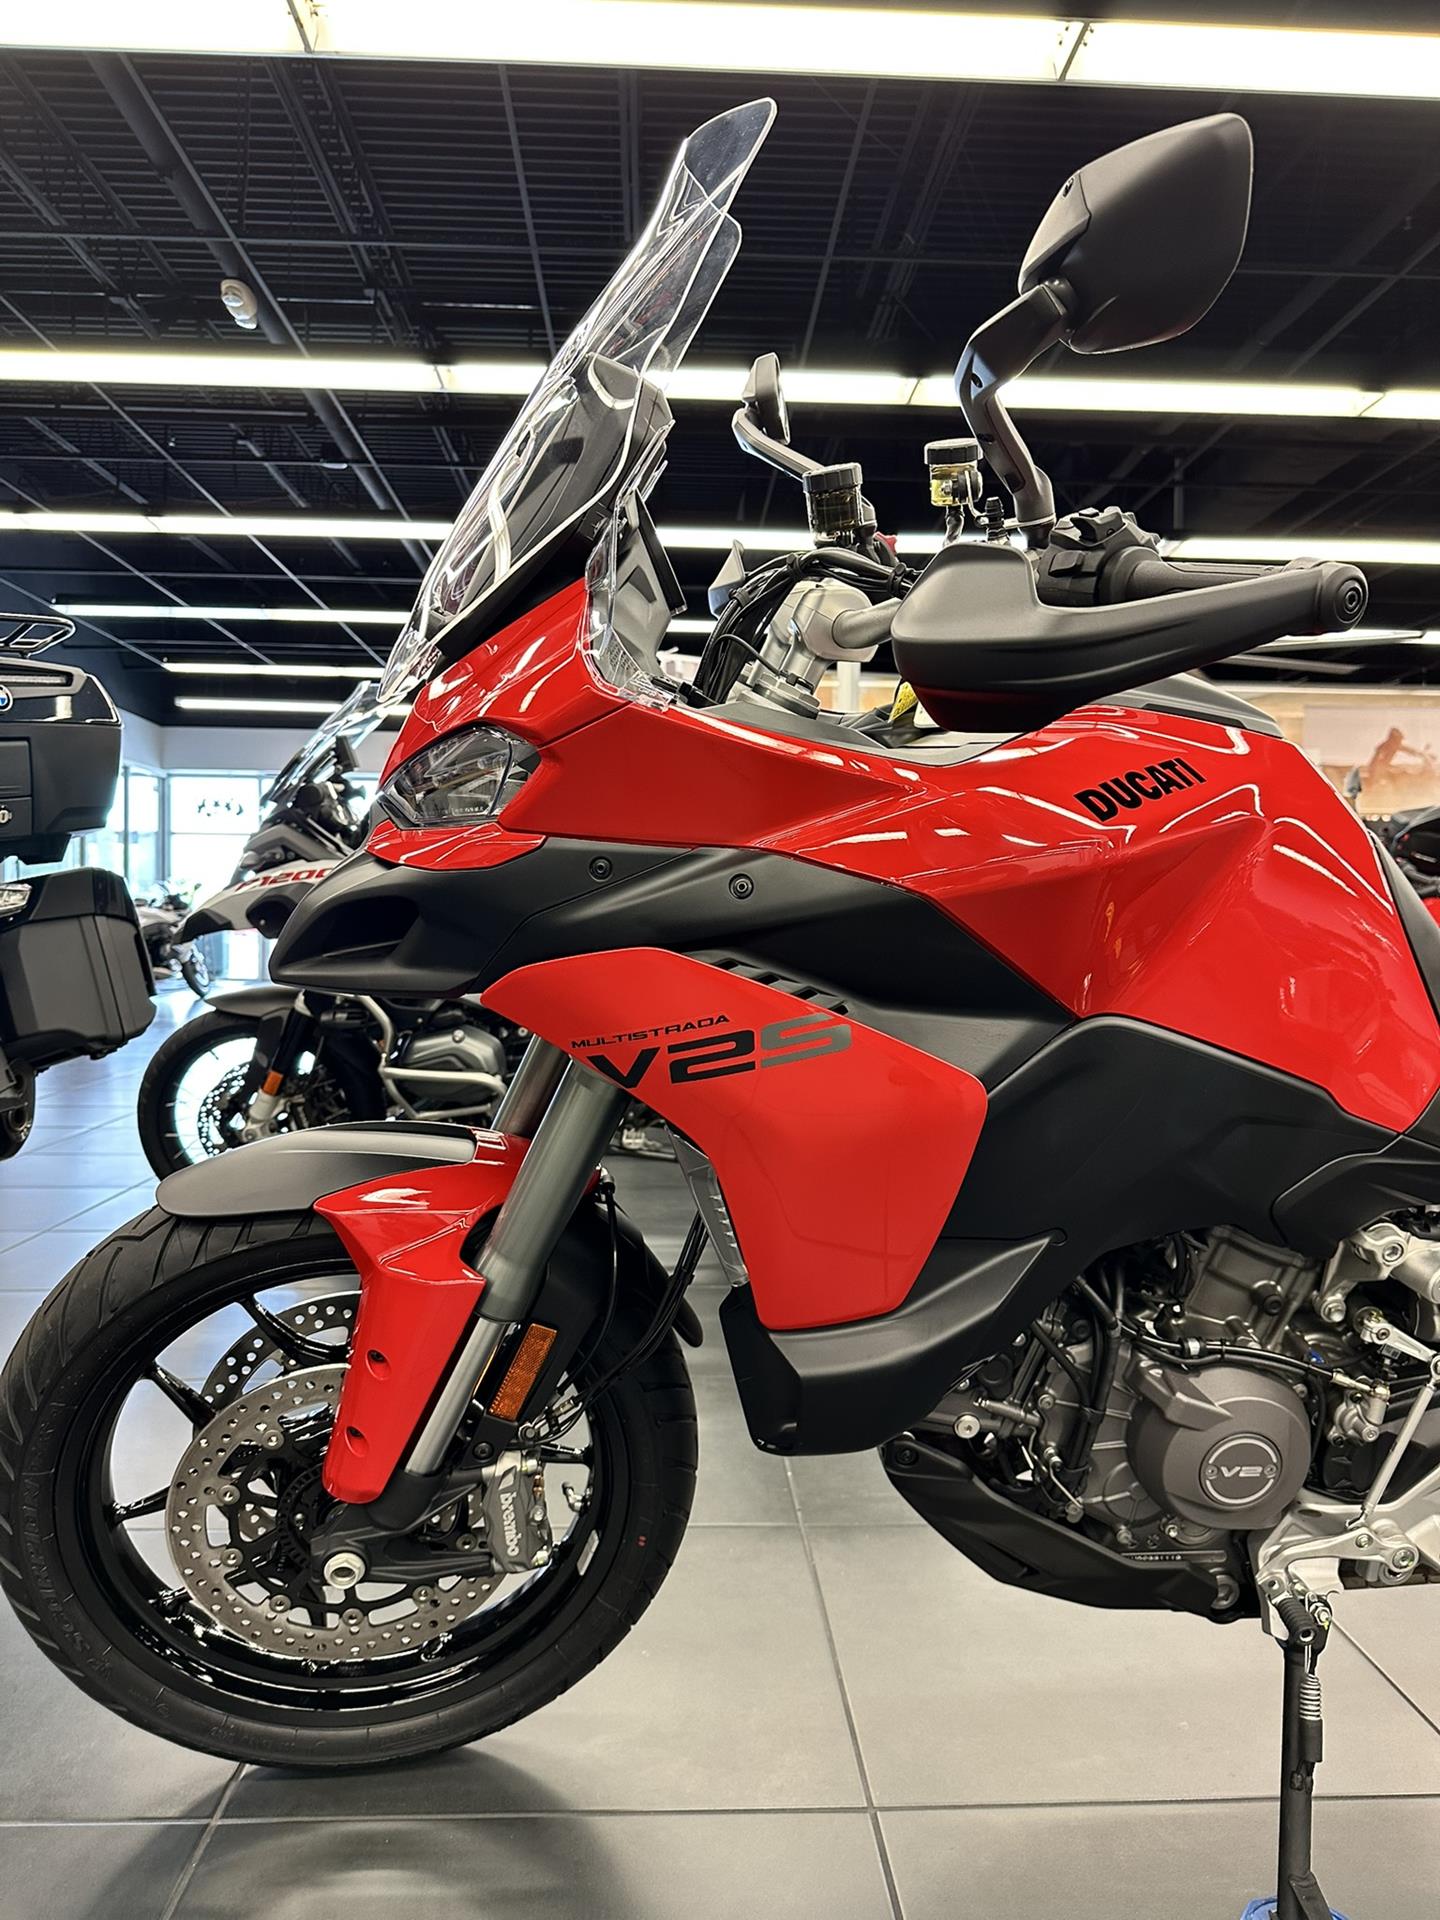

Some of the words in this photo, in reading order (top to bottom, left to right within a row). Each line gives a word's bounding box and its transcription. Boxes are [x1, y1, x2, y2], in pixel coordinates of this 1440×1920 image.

[1073, 757, 1208, 823] DUCATI
[571, 1014, 731, 1049] MULTISTRADA
[1220, 1465, 1263, 1478] V2
[499, 1491, 522, 1557] brembo
